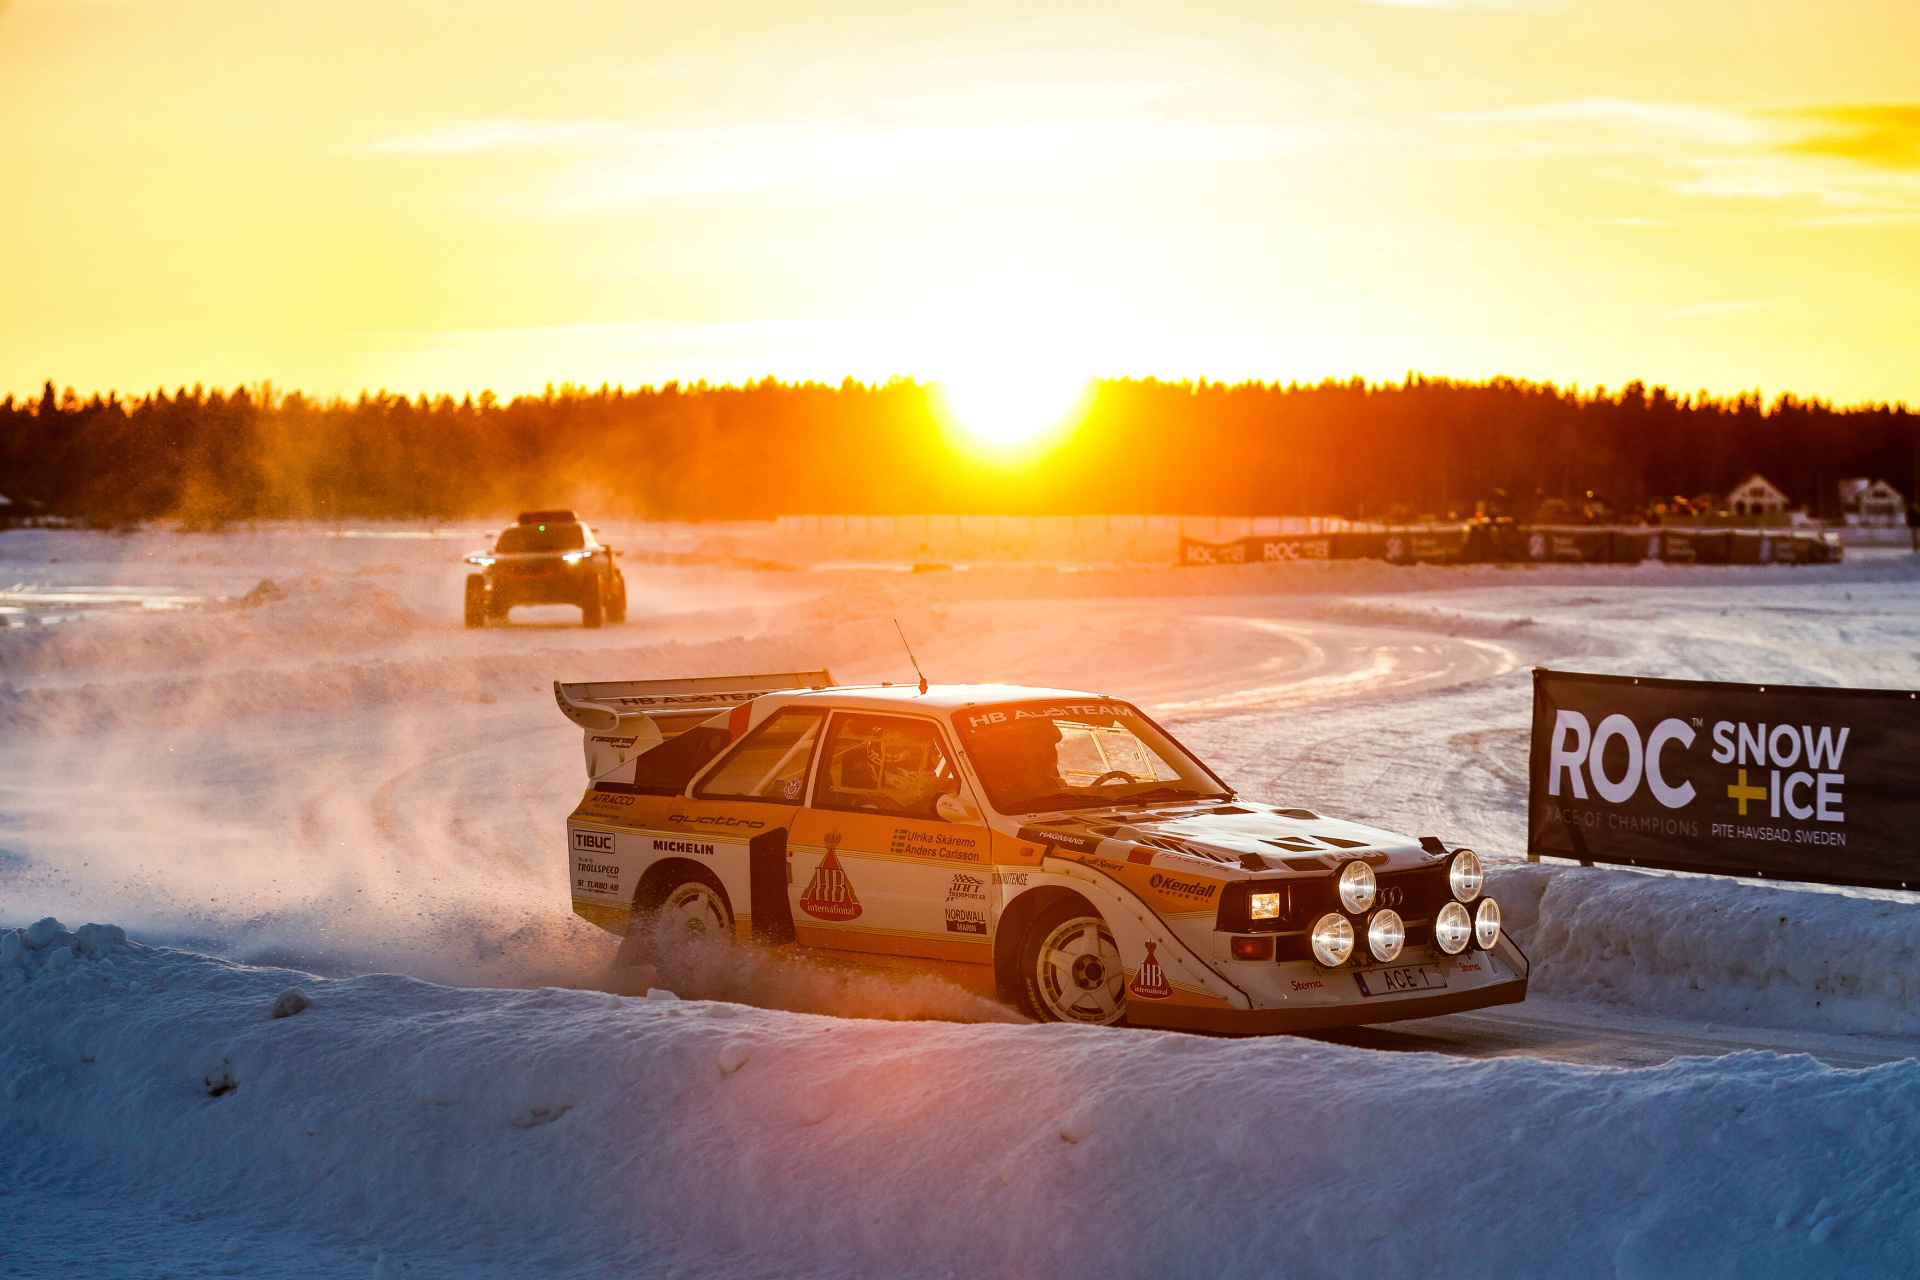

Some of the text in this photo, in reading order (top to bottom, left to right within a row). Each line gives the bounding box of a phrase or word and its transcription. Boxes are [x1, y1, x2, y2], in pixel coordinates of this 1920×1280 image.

[620, 697, 656, 706] HB
[969, 711, 1008, 728] HB
[1711, 721, 1850, 770] SNOW
[1548, 709, 1697, 808] ROC
[590, 794, 636, 806] ATRACCO
[667, 814, 766, 828] quattro
[1546, 806, 1698, 836] RACE OF CHAMPIONS
[576, 834, 612, 849] TIBUC
[907, 831, 976, 848] Ulrika Skäremo
[1039, 831, 1085, 845] HAGMANS
[1712, 823, 1734, 838] PITE
[1795, 830, 1846, 845] SWEDEN
[653, 840, 714, 855] MICHELIN
[904, 844, 980, 861] Anders Carlsson
[578, 863, 620, 875] TROLLSPEED
[1078, 856, 1124, 872] Audi Sport
[587, 881, 608, 890] TURBO
[609, 884, 619, 892] AB
[815, 868, 846, 903] HB
[1161, 877, 1217, 898] Kendall
[949, 891, 979, 900] TRANSPORT
[1158, 889, 1210, 904] MOTOR OIL
[807, 902, 855, 916] international
[945, 909, 986, 922] NORDWALL
[957, 923, 977, 932] MARIN
[1140, 963, 1163, 987] HB
[1384, 967, 1430, 991] ACE 1
[1134, 985, 1168, 996] international
